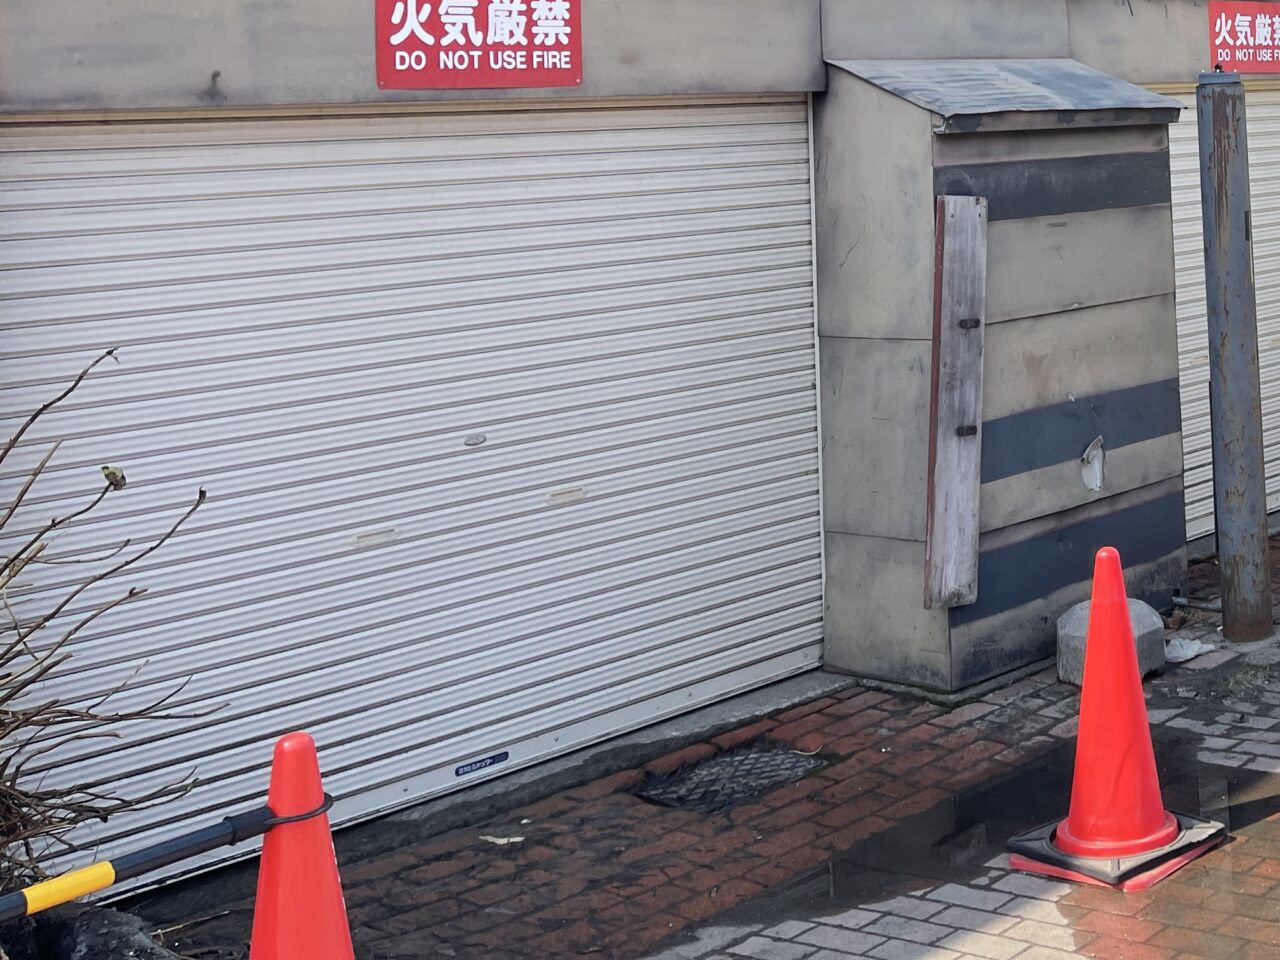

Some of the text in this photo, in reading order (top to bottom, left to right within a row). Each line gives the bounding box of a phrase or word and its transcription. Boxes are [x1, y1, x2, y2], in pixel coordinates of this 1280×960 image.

[395, 51, 572, 70] DO NOT USE FIRE
[1217, 48, 1231, 61] DO
[1235, 49, 1254, 61] NOT
[1256, 49, 1273, 61] USE
